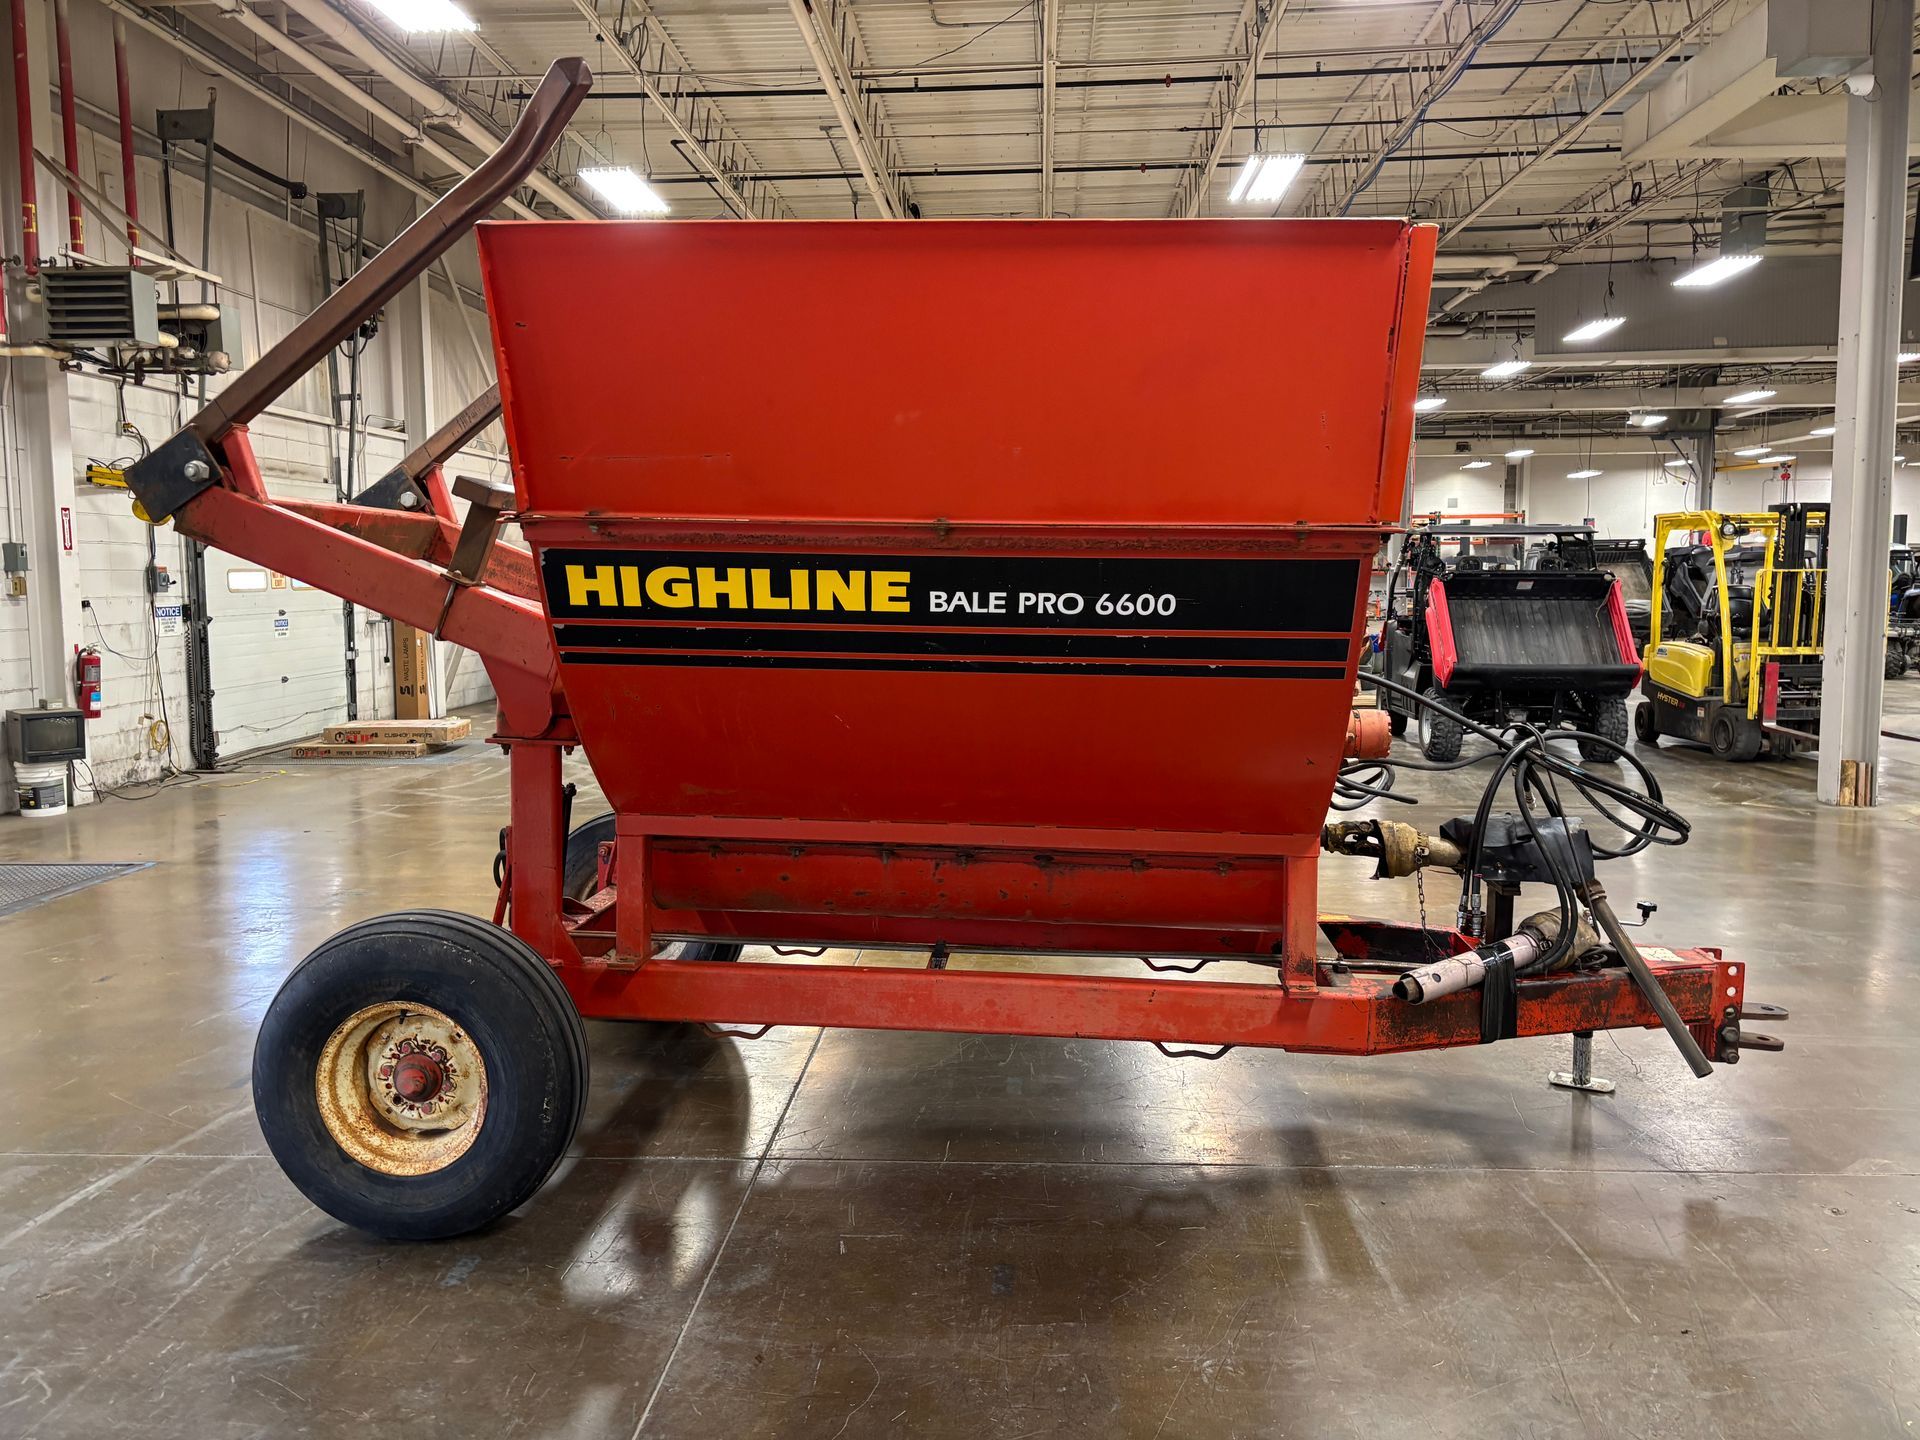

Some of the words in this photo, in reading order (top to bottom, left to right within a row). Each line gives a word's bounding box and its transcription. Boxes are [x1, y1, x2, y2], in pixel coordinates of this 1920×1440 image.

[1778, 514, 1787, 562] HYSTER
[275, 579, 283, 587] EXIT
[565, 565, 911, 613] HIGHLINE
[929, 591, 1007, 613] BALE
[1018, 592, 1085, 615] PRO
[1095, 593, 1177, 616] 6600
[156, 607, 180, 617] NOTICE
[1657, 691, 1679, 708] HYSTER
